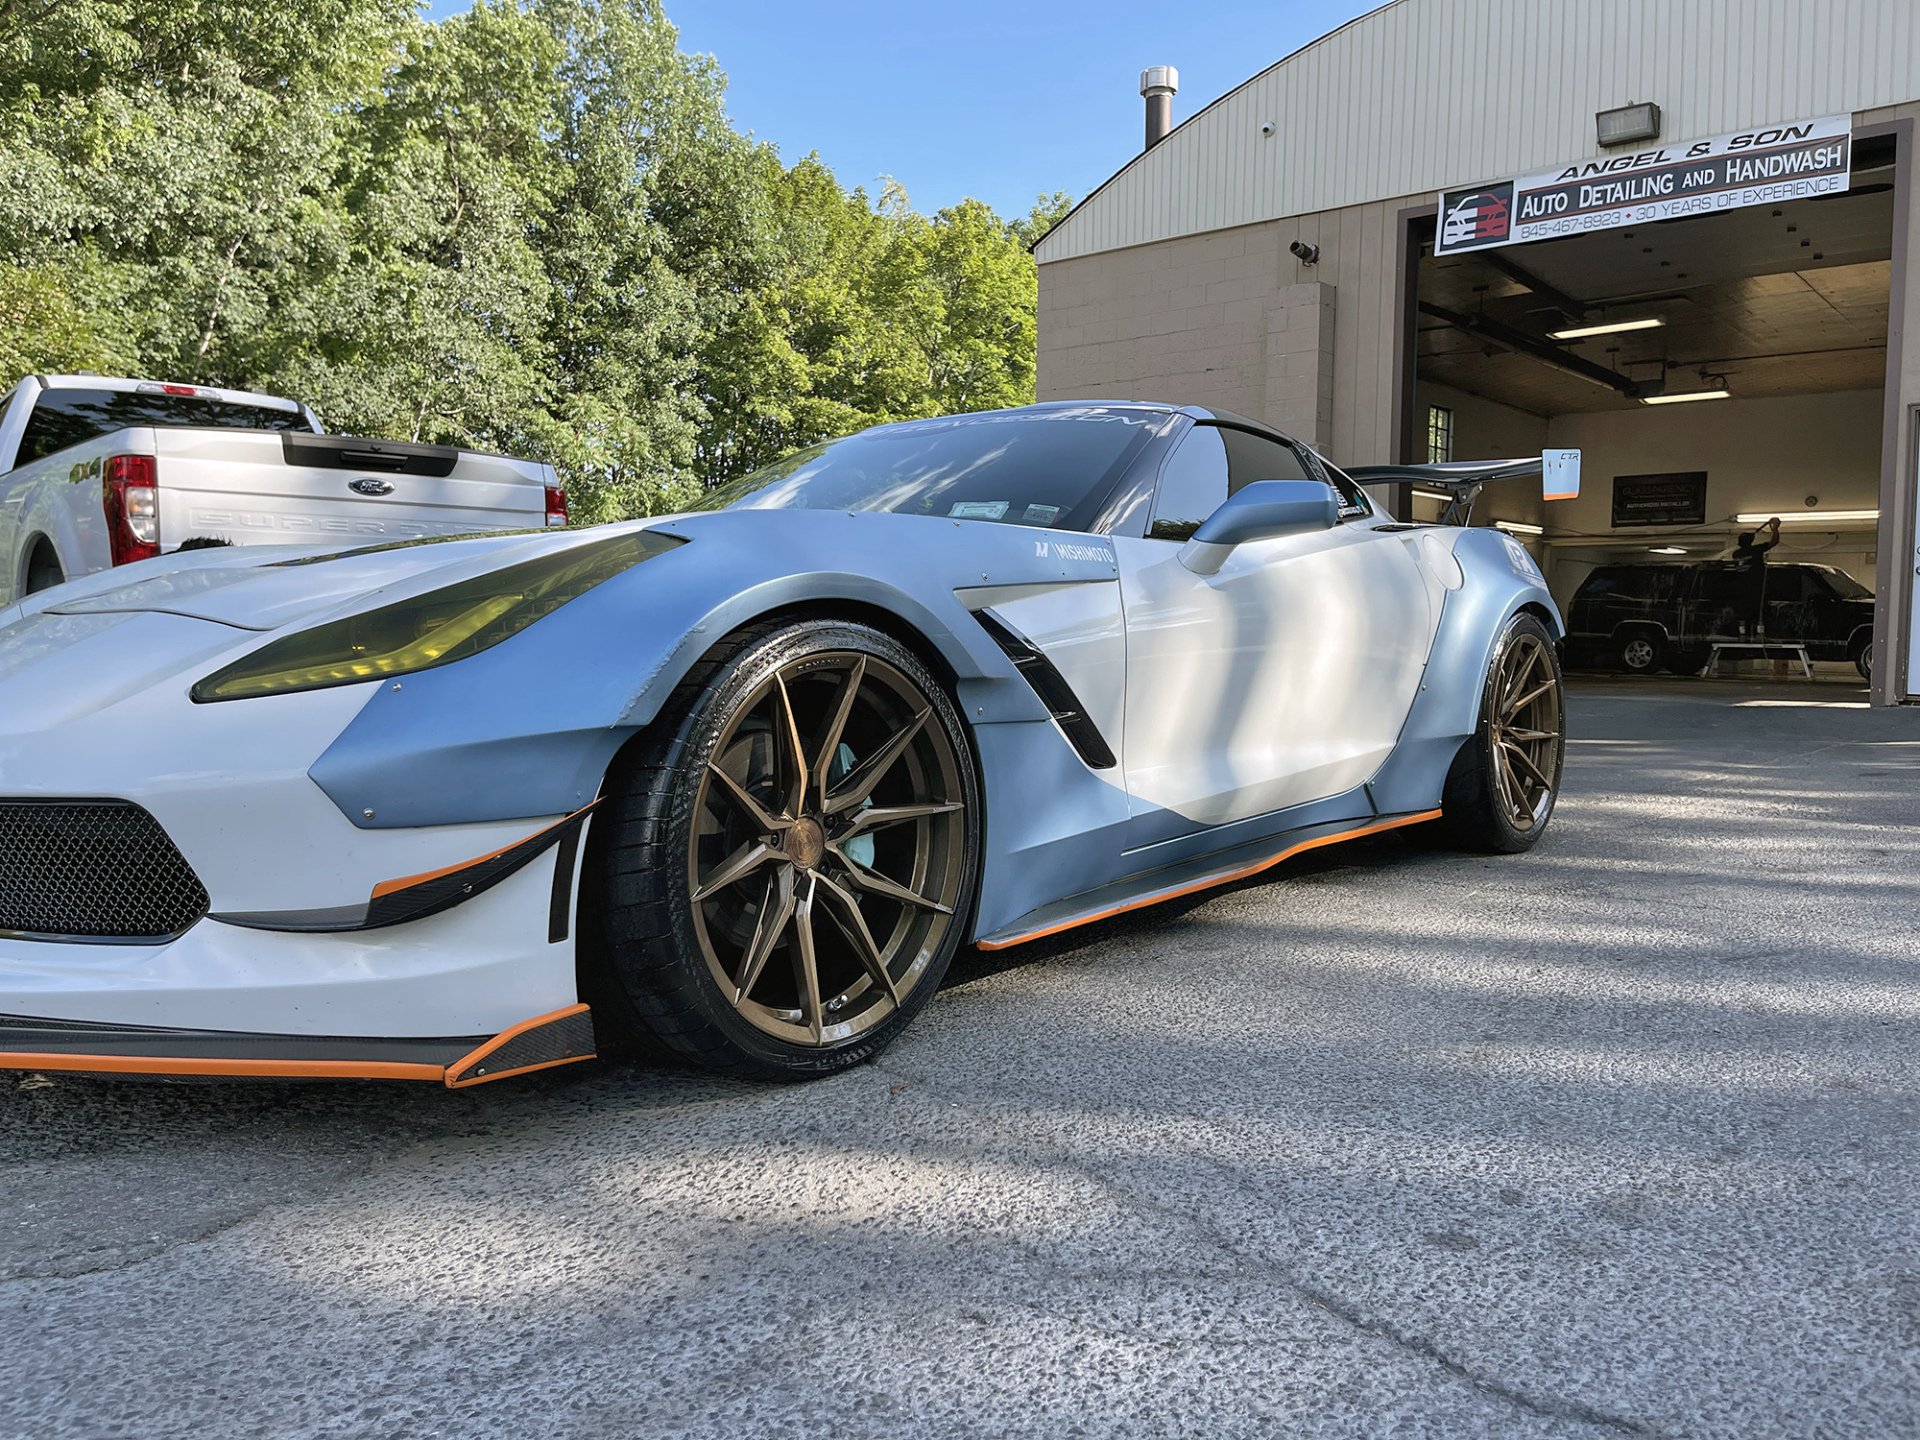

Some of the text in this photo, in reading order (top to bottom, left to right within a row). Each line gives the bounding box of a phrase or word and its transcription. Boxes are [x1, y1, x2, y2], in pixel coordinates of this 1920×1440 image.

[1521, 145, 1843, 219] AUTO DETAILING AND HANDWASH
[1554, 124, 1814, 182] ANGEL & SON
[1521, 177, 1839, 239] 845-467-8923 30 YEARS OF EXPERIENCE
[198, 513, 385, 534] SUPER
[1055, 543, 1115, 564] MISHIMOTO
